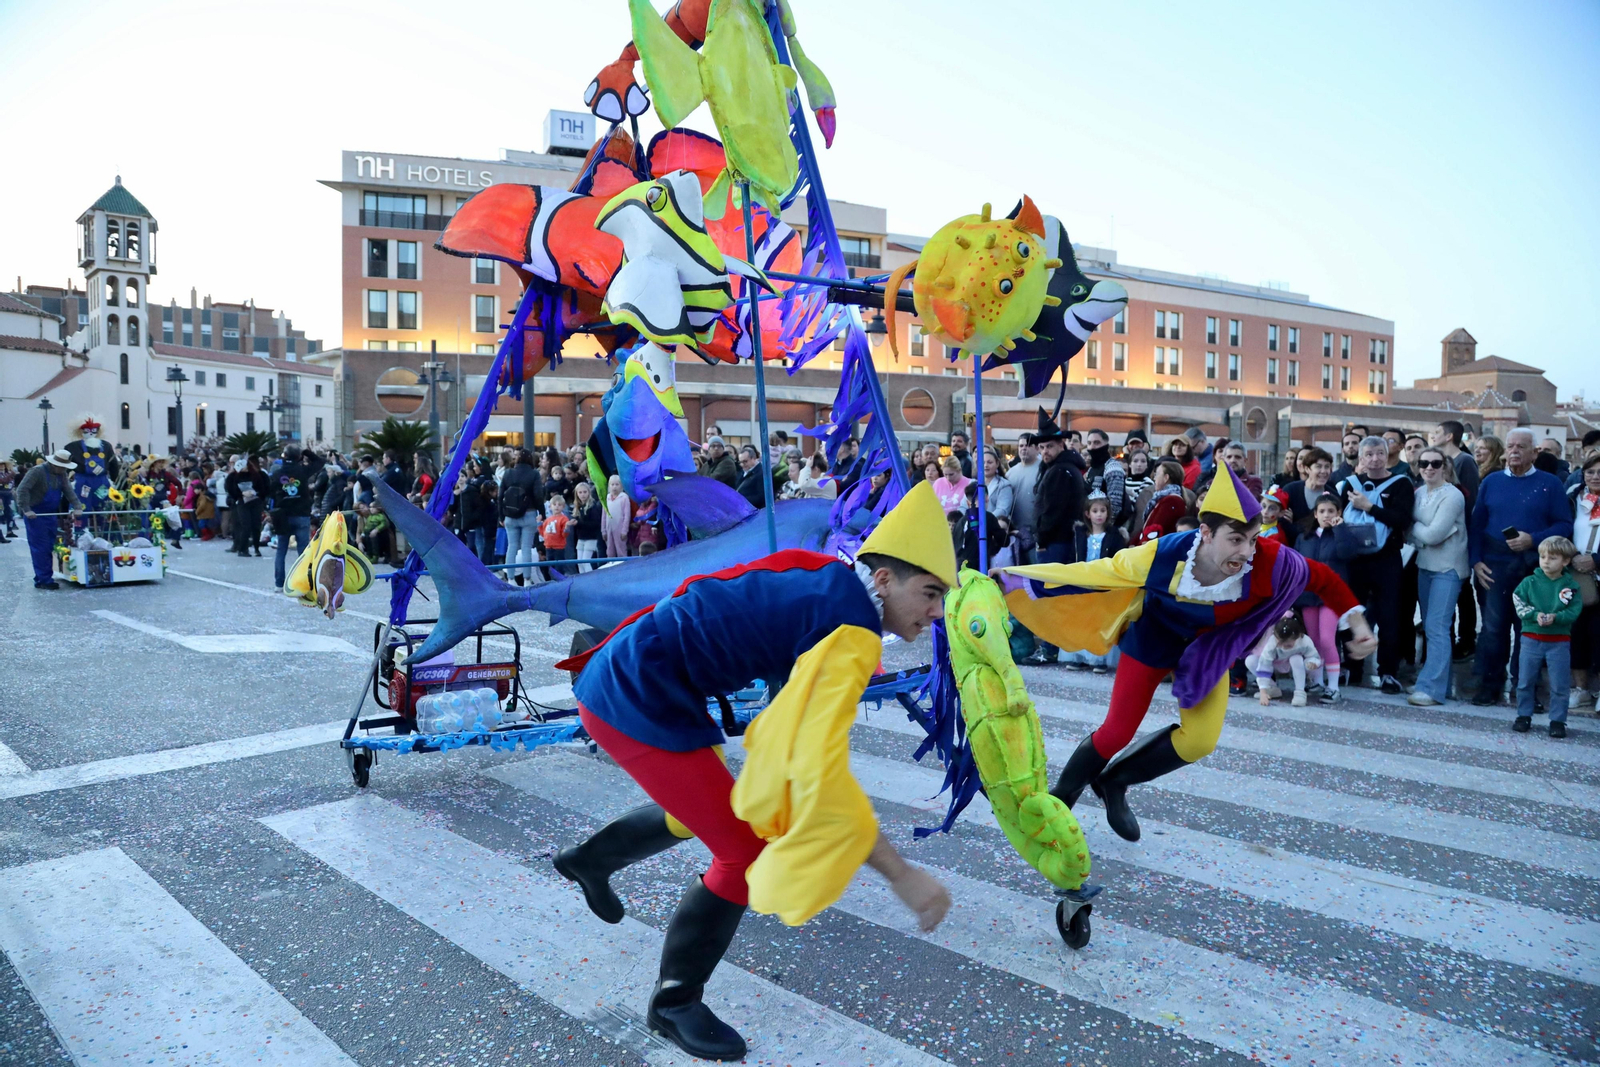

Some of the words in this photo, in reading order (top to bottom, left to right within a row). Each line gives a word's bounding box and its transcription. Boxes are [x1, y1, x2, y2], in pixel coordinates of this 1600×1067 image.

[560, 133, 584, 141] HOTELS
[407, 164, 493, 188] HOTELS
[467, 669, 511, 679] GENERATOR
